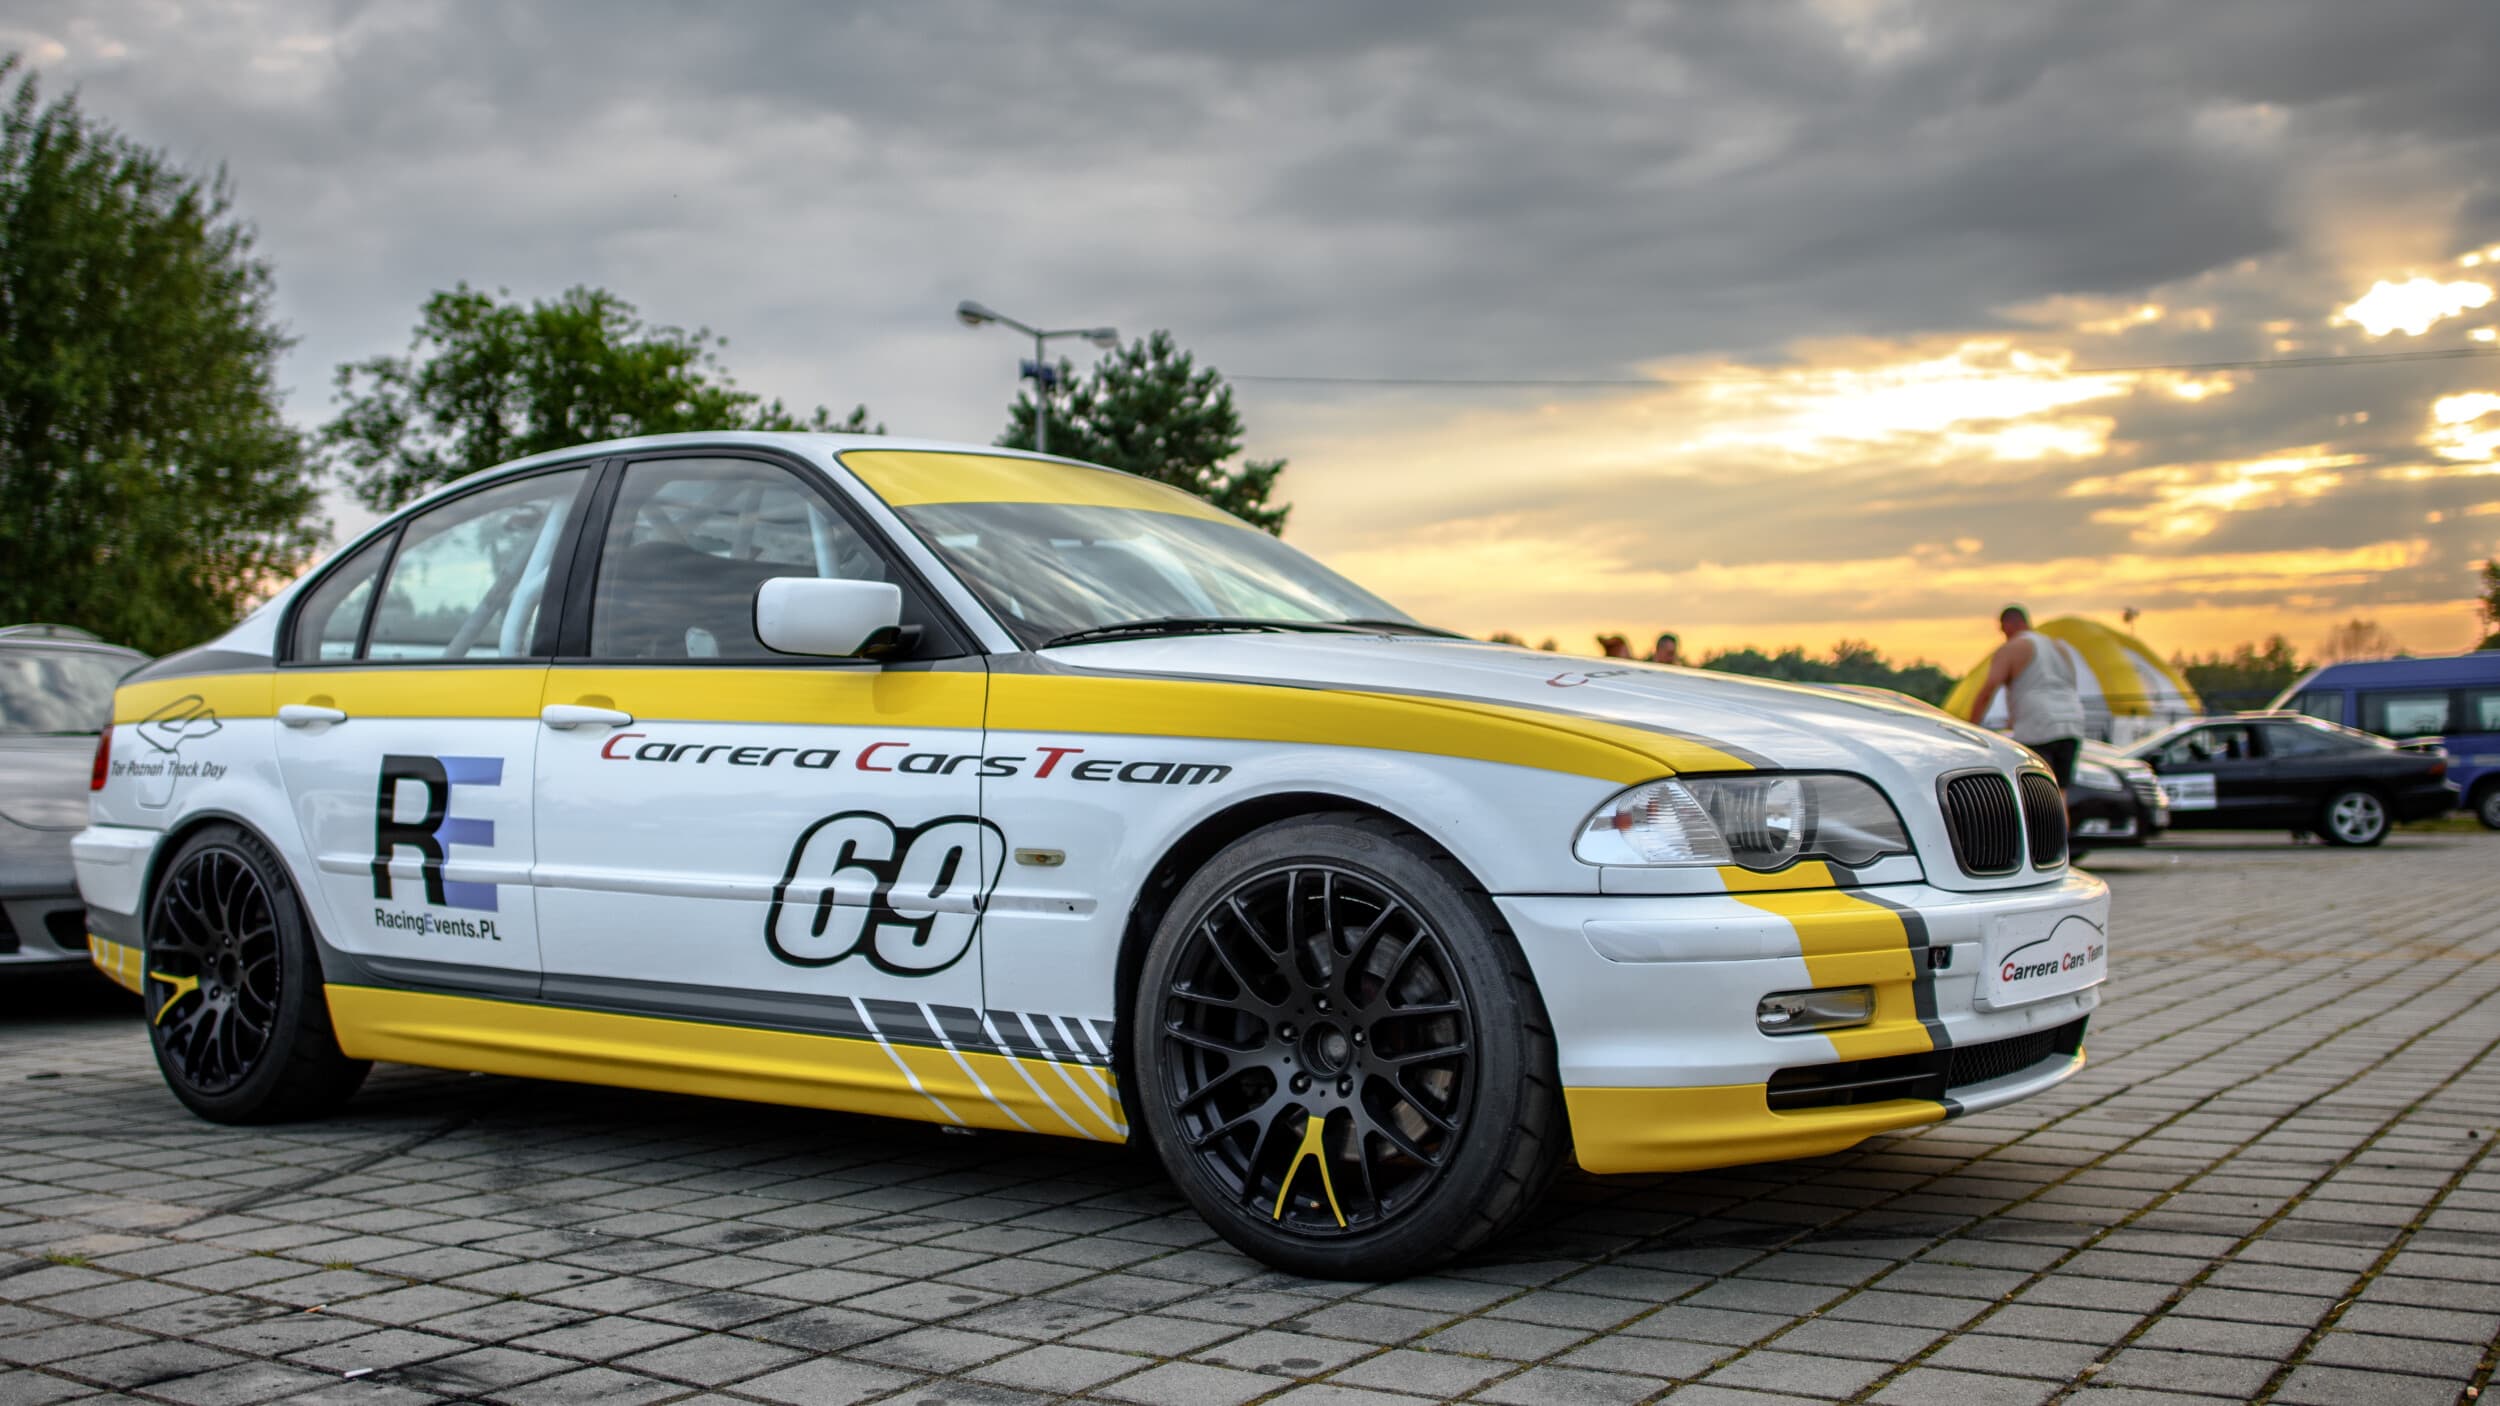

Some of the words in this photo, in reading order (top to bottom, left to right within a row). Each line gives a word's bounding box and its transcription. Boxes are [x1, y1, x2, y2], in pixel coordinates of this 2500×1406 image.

[111, 760, 125, 777] Tor
[167, 760, 199, 777] Track
[201, 761, 227, 780] Day
[599, 732, 842, 769] Carrera
[854, 741, 1027, 778] Cars
[1032, 746, 1234, 786] Team
[763, 809, 1007, 978] 69
[375, 908, 502, 941] RacingEvents.PL
[2002, 960, 2059, 982] Carrera
[2063, 952, 2085, 971] Cars
[2087, 944, 2104, 963] Team
